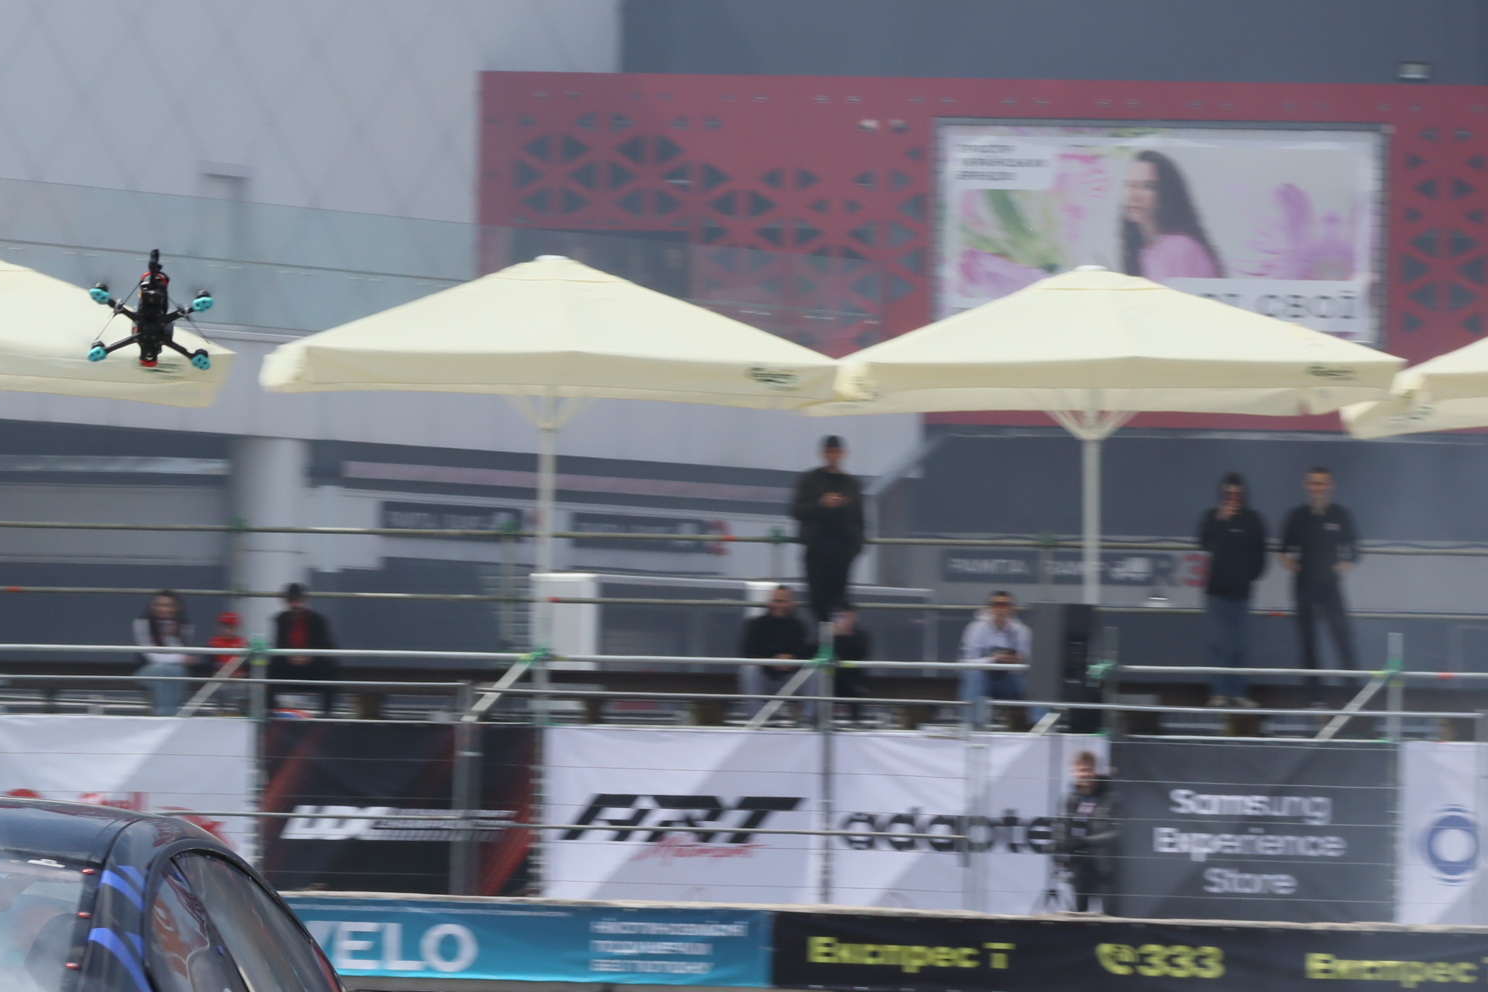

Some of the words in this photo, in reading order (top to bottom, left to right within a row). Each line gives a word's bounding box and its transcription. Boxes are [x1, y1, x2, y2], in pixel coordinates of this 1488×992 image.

[1169, 788, 1332, 826] Samsung
[838, 806, 1060, 869] adapte
[1153, 826, 1349, 863] Experience
[1203, 867, 1298, 895] Store
[1134, 943, 1227, 979] 333
